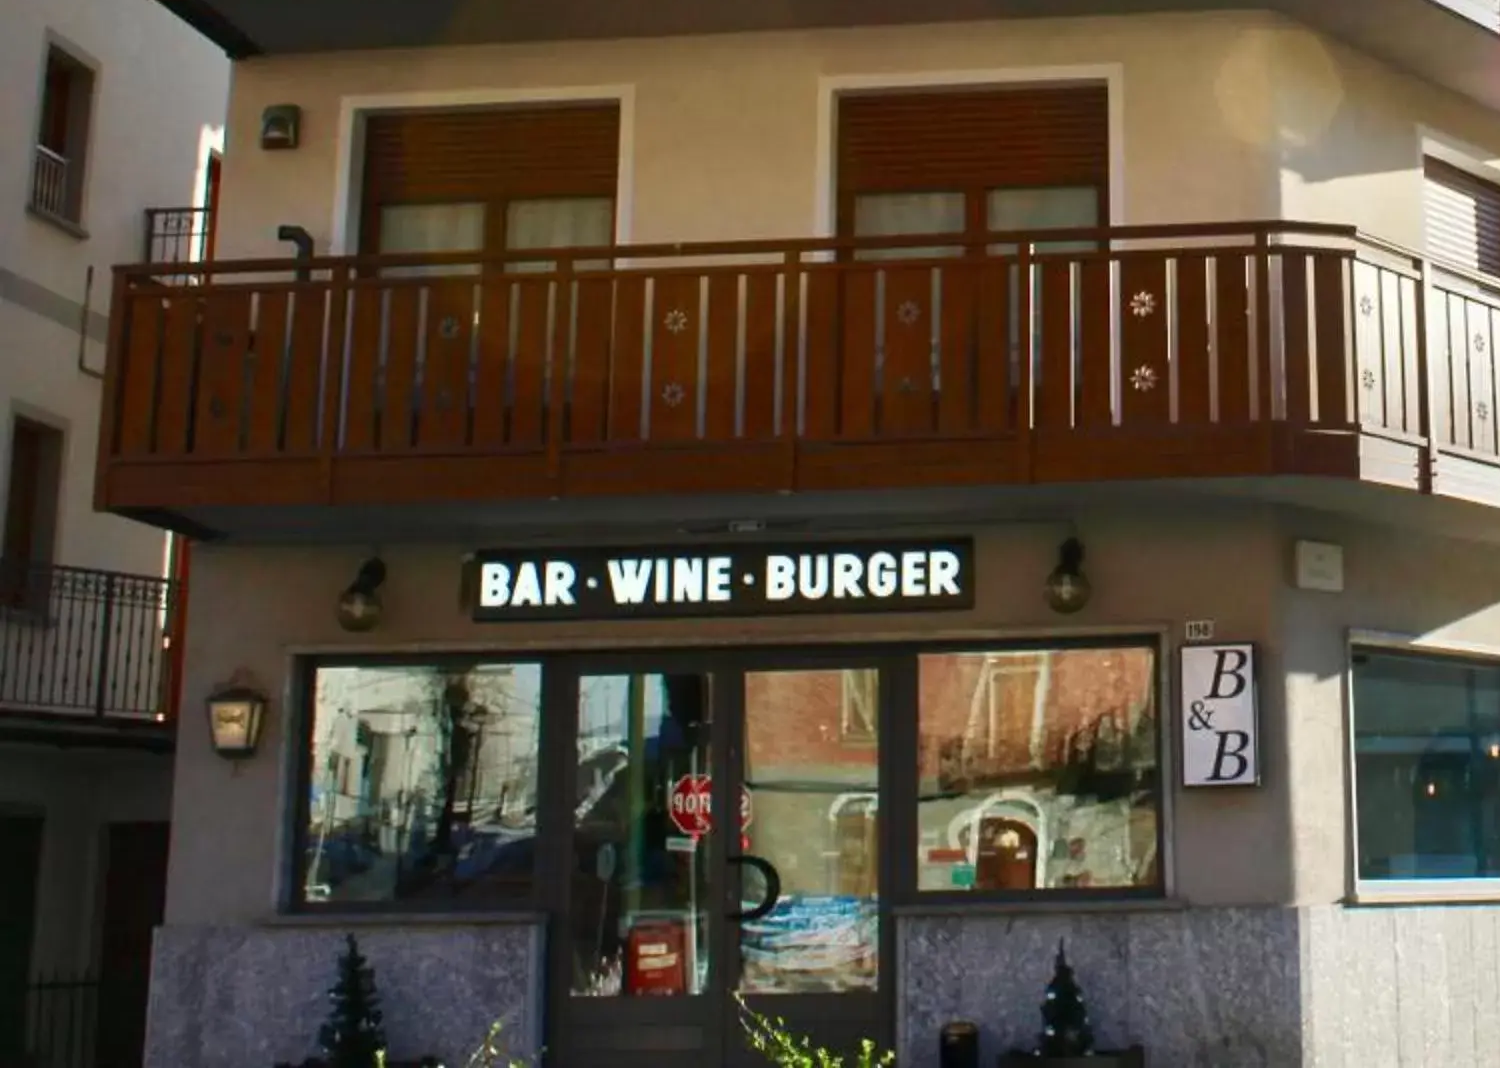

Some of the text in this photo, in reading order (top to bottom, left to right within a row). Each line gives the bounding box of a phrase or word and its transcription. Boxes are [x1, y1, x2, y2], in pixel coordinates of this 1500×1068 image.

[480, 551, 961, 607] BAR WINE BURGER
[1203, 649, 1248, 700] B
[1187, 701, 1214, 731] &
[1205, 730, 1250, 782] B
